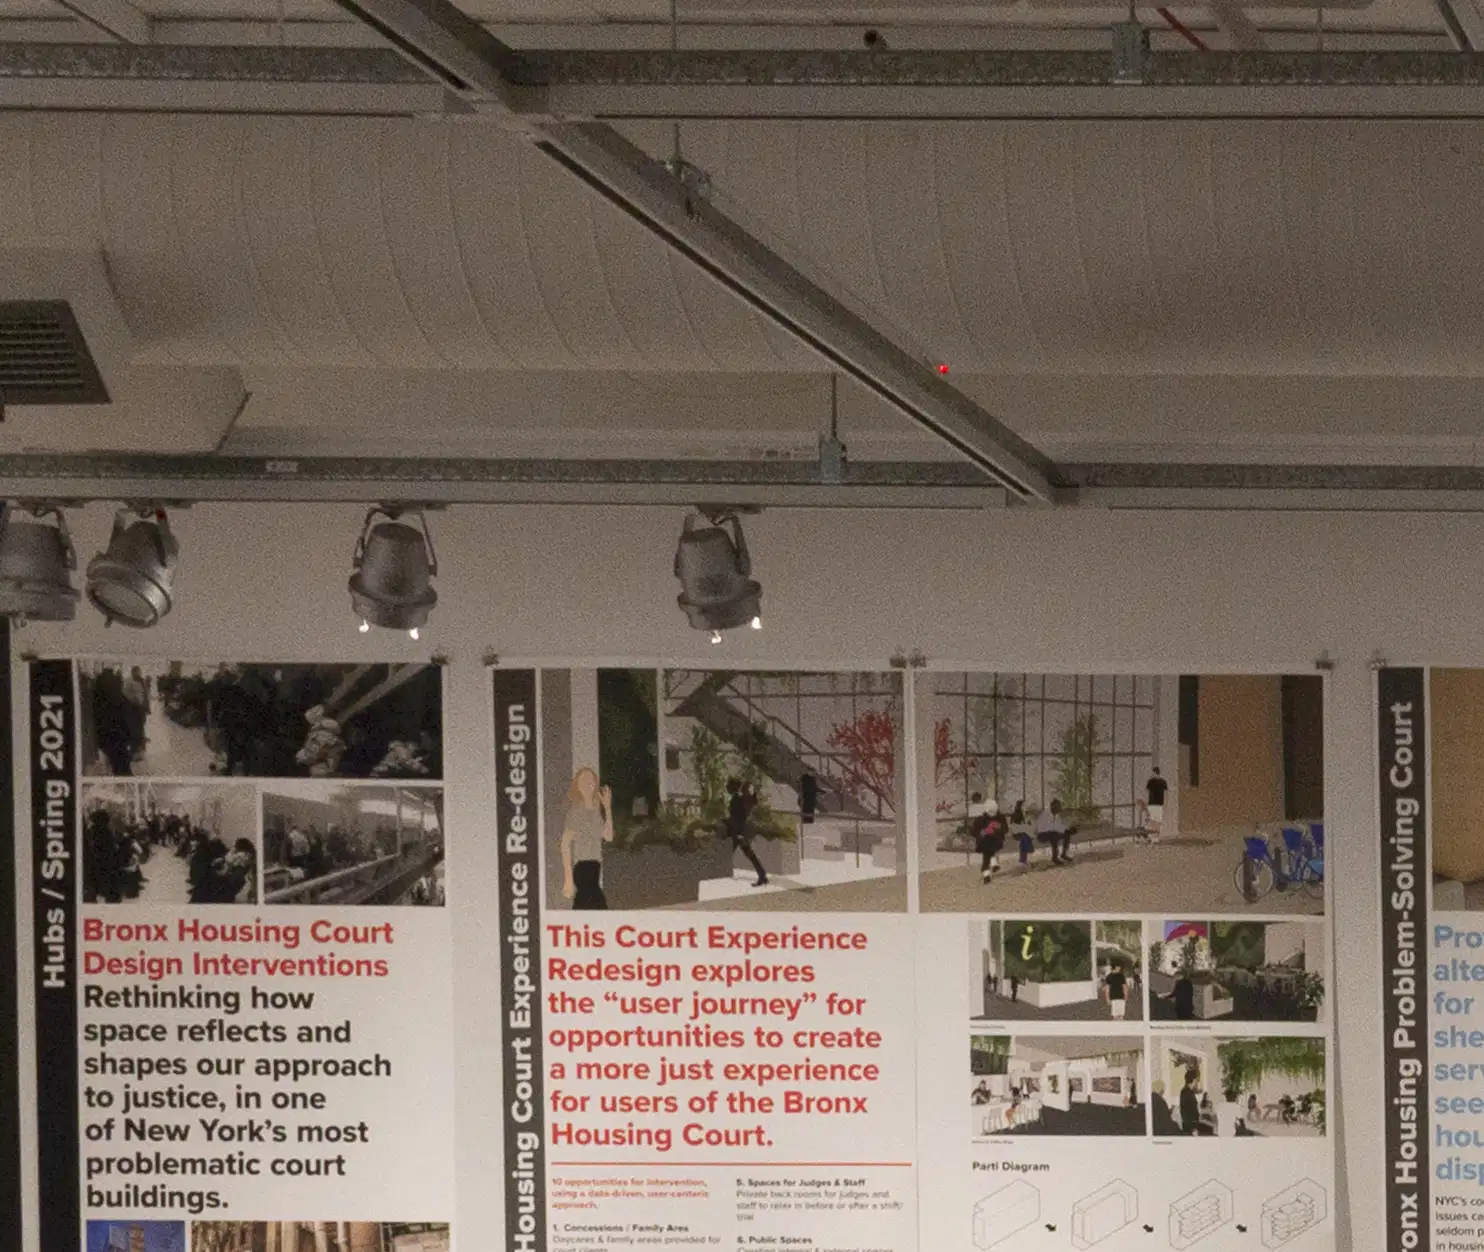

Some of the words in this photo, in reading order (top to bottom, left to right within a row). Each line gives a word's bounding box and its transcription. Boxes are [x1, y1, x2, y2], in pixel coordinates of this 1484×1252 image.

[41, 696, 63, 769] 2021
[1391, 703, 1412, 787] Court
[504, 706, 529, 852] Re-design
[40, 781, 69, 879] Spring
[42, 889, 64, 899] /
[84, 919, 167, 941] Bronx
[179, 919, 299, 948] Housing
[311, 920, 393, 943] Court
[1391, 799, 1419, 1048] Problem-Solving
[43, 909, 65, 987] Hubs
[508, 863, 535, 1028] Experience
[547, 925, 605, 947] This
[616, 925, 697, 948] Court
[708, 926, 867, 954] Experience
[84, 951, 182, 980] Design
[194, 952, 388, 976] Interventions
[549, 958, 680, 987] Redesign
[692, 959, 815, 987] explores
[85, 984, 240, 1014] Rethinking
[252, 986, 314, 1009] how
[549, 1024, 744, 1052] opportunities
[754, 1027, 783, 1047] to
[793, 1028, 881, 1048] create
[512, 1038, 532, 1122] Court
[1394, 1059, 1421, 1183] Housing
[552, 1122, 671, 1151] Housing
[683, 1123, 772, 1146] Court.
[87, 1151, 260, 1180] problematic
[271, 1155, 345, 1175] court
[972, 1161, 998, 1170] Parti
[1002, 1162, 1049, 1173] Diagram
[87, 1184, 228, 1214] buildings.
